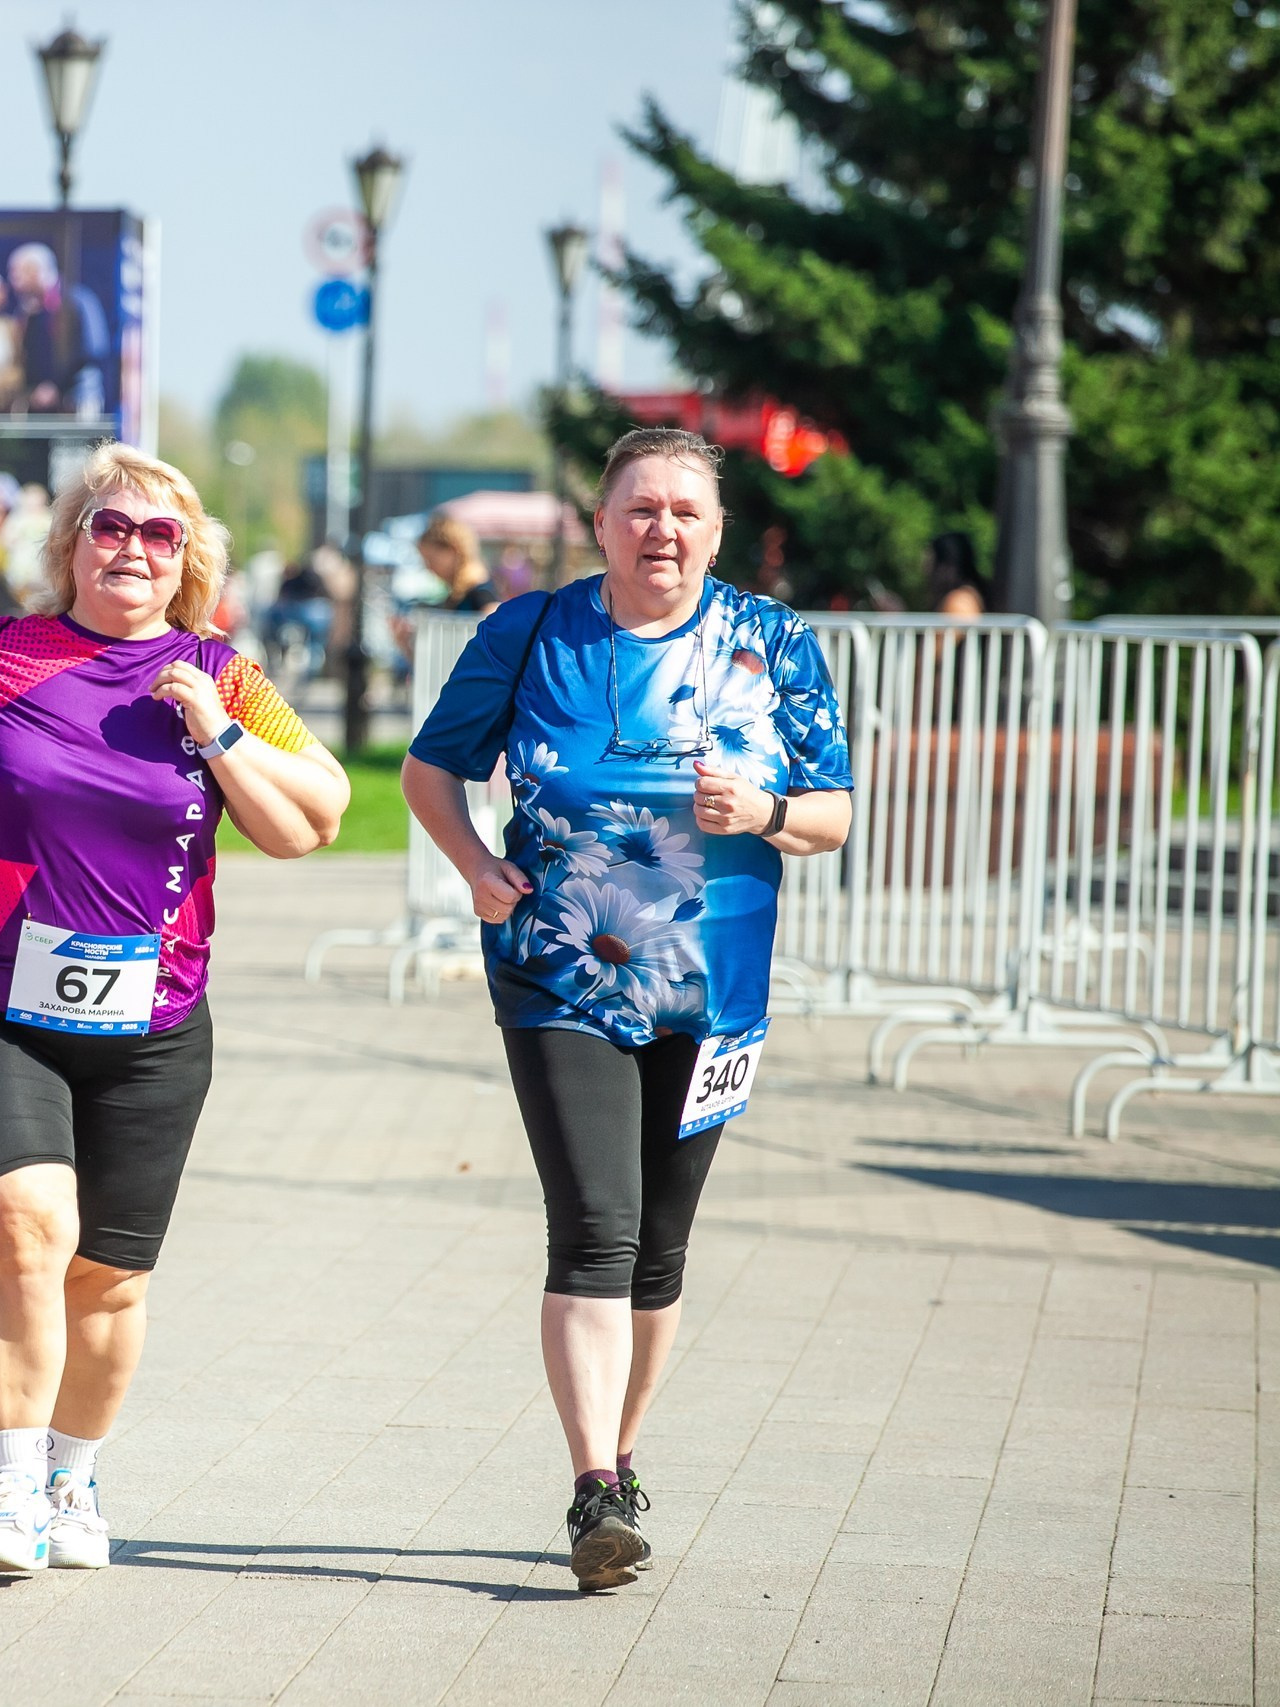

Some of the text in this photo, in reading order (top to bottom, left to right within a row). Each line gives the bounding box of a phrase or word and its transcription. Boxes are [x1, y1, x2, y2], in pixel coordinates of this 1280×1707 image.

[34, 935, 54, 945] СБЕР
[84, 948, 109, 956] МОСТЫ
[55, 965, 121, 1006] 67
[38, 1001, 125, 1017] ЗАХАРОВА МАРИНА
[695, 1053, 750, 1104] 340
